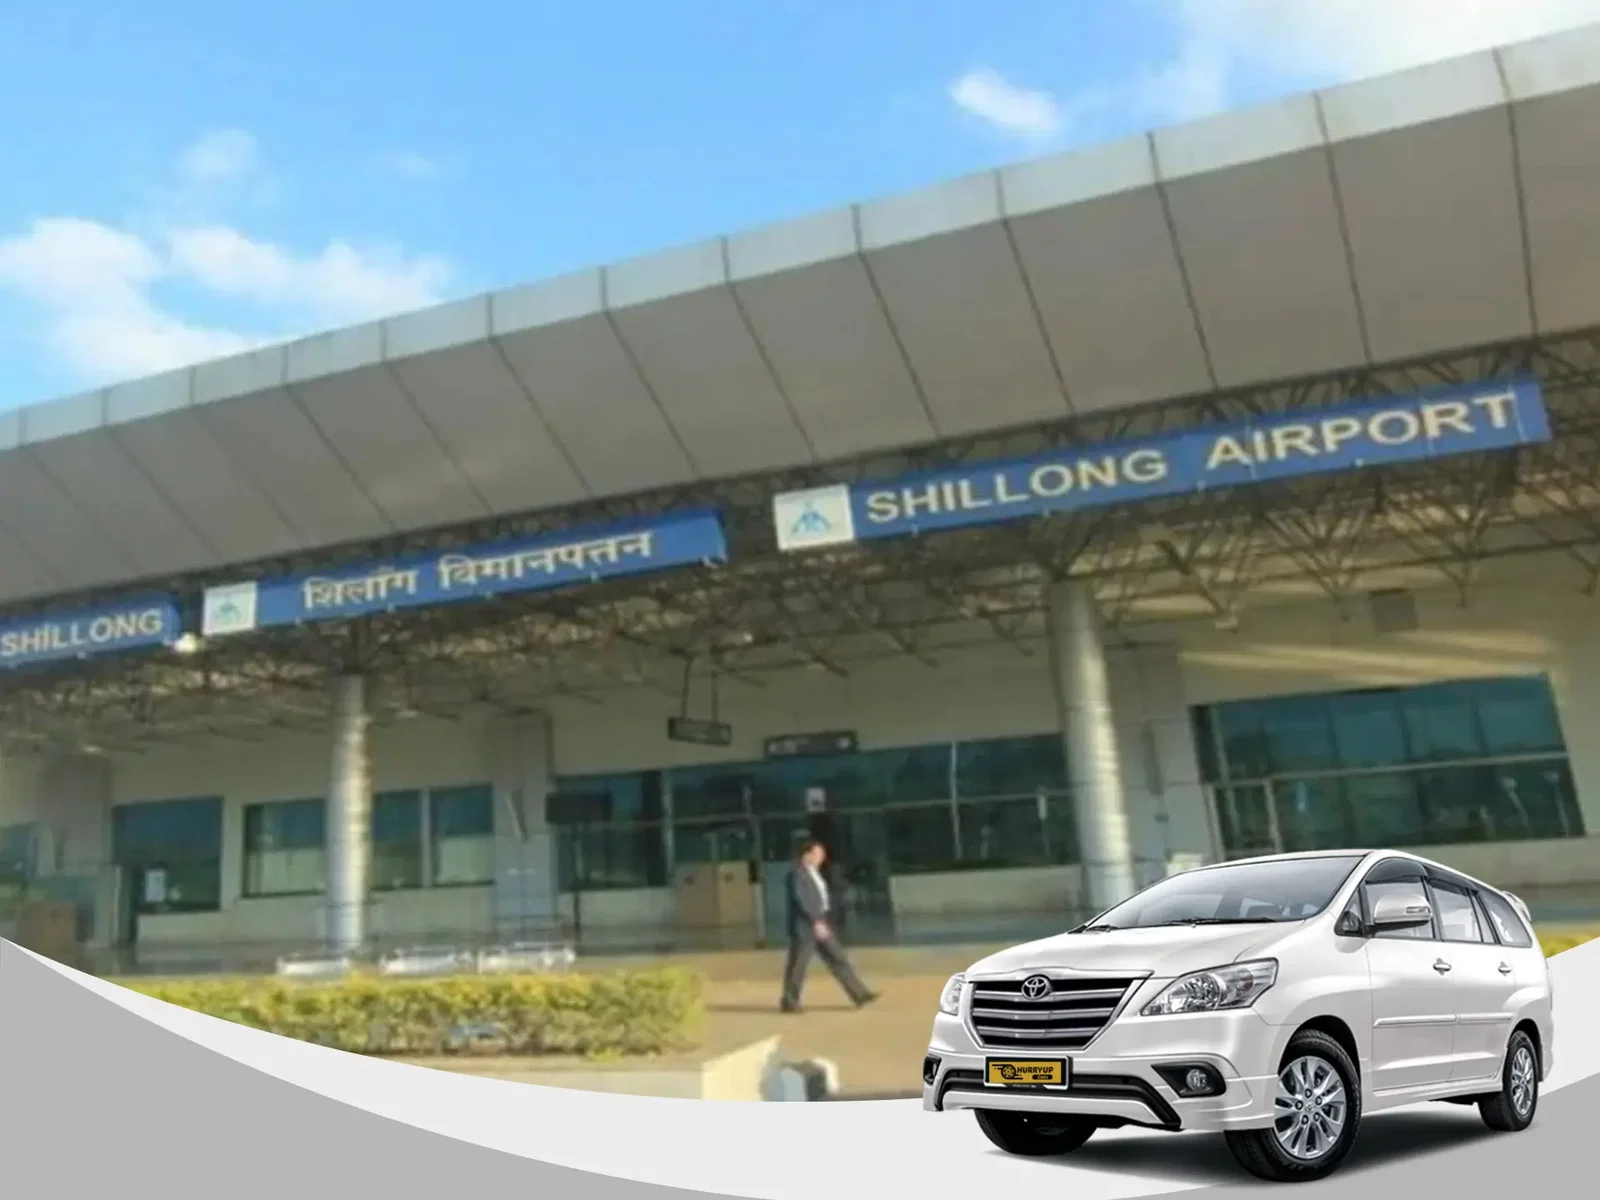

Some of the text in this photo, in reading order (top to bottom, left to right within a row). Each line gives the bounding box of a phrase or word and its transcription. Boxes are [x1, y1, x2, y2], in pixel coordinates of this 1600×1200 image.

[866, 392, 1516, 523] SHILLONG AIRPORT
[0, 607, 163, 657] SHILLONG
[1017, 1066, 1053, 1074] HURRYUP
